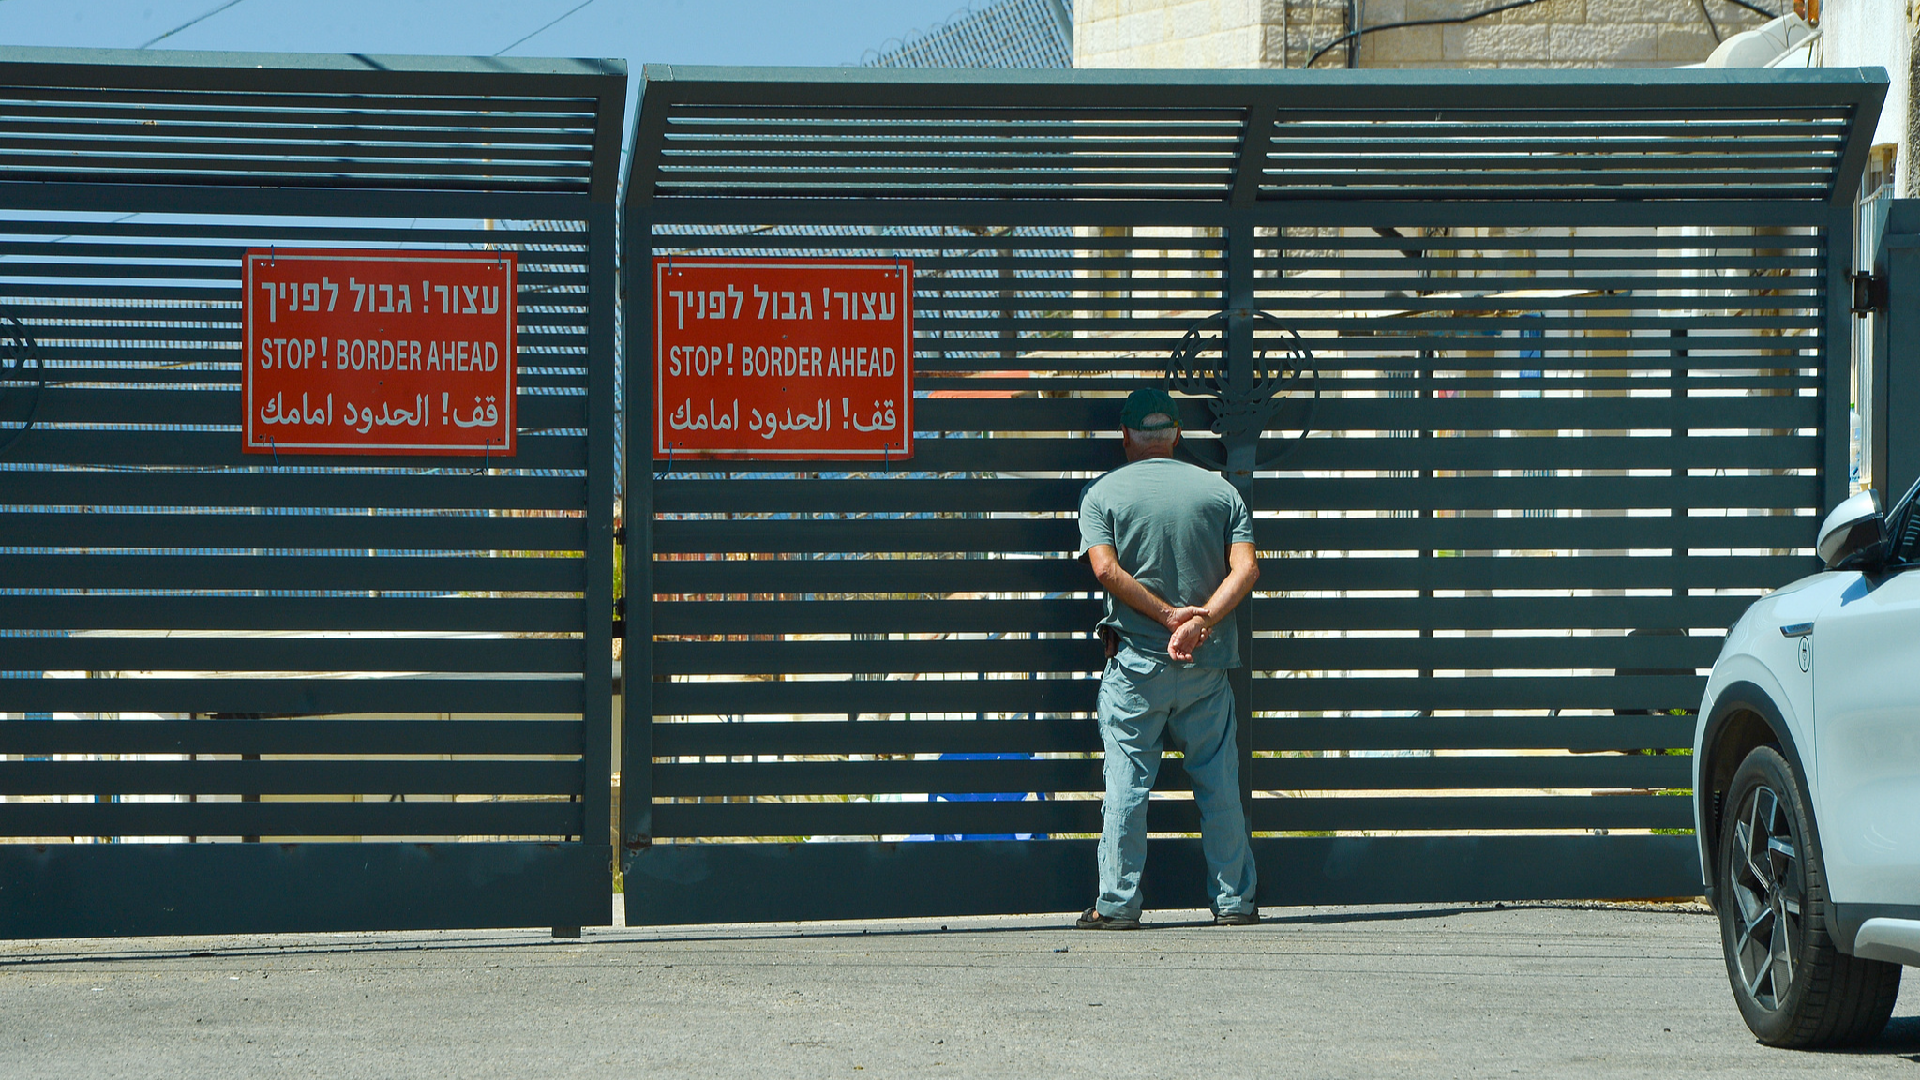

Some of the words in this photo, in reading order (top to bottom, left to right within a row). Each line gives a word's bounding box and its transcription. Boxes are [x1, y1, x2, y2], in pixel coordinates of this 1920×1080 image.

[261, 276, 339, 323] לפניך
[349, 276, 412, 313] גבול
[422, 280, 499, 314] עצור!
[669, 284, 744, 330] לפניך
[753, 284, 813, 320] גבול
[822, 287, 896, 320] עצור!
[261, 336, 328, 370] STOP!
[337, 339, 422, 371] BORDER
[426, 340, 499, 372] AHEAD
[669, 343, 734, 377] STOP!
[742, 346, 823, 377] BORDER
[827, 347, 896, 377] AHEAD
[260, 391, 333, 426] امامك
[343, 393, 429, 434] الحدود
[442, 392, 499, 428] قف!
[669, 397, 739, 431] امامك
[748, 398, 831, 440] الحدود
[842, 397, 897, 432] قف!
